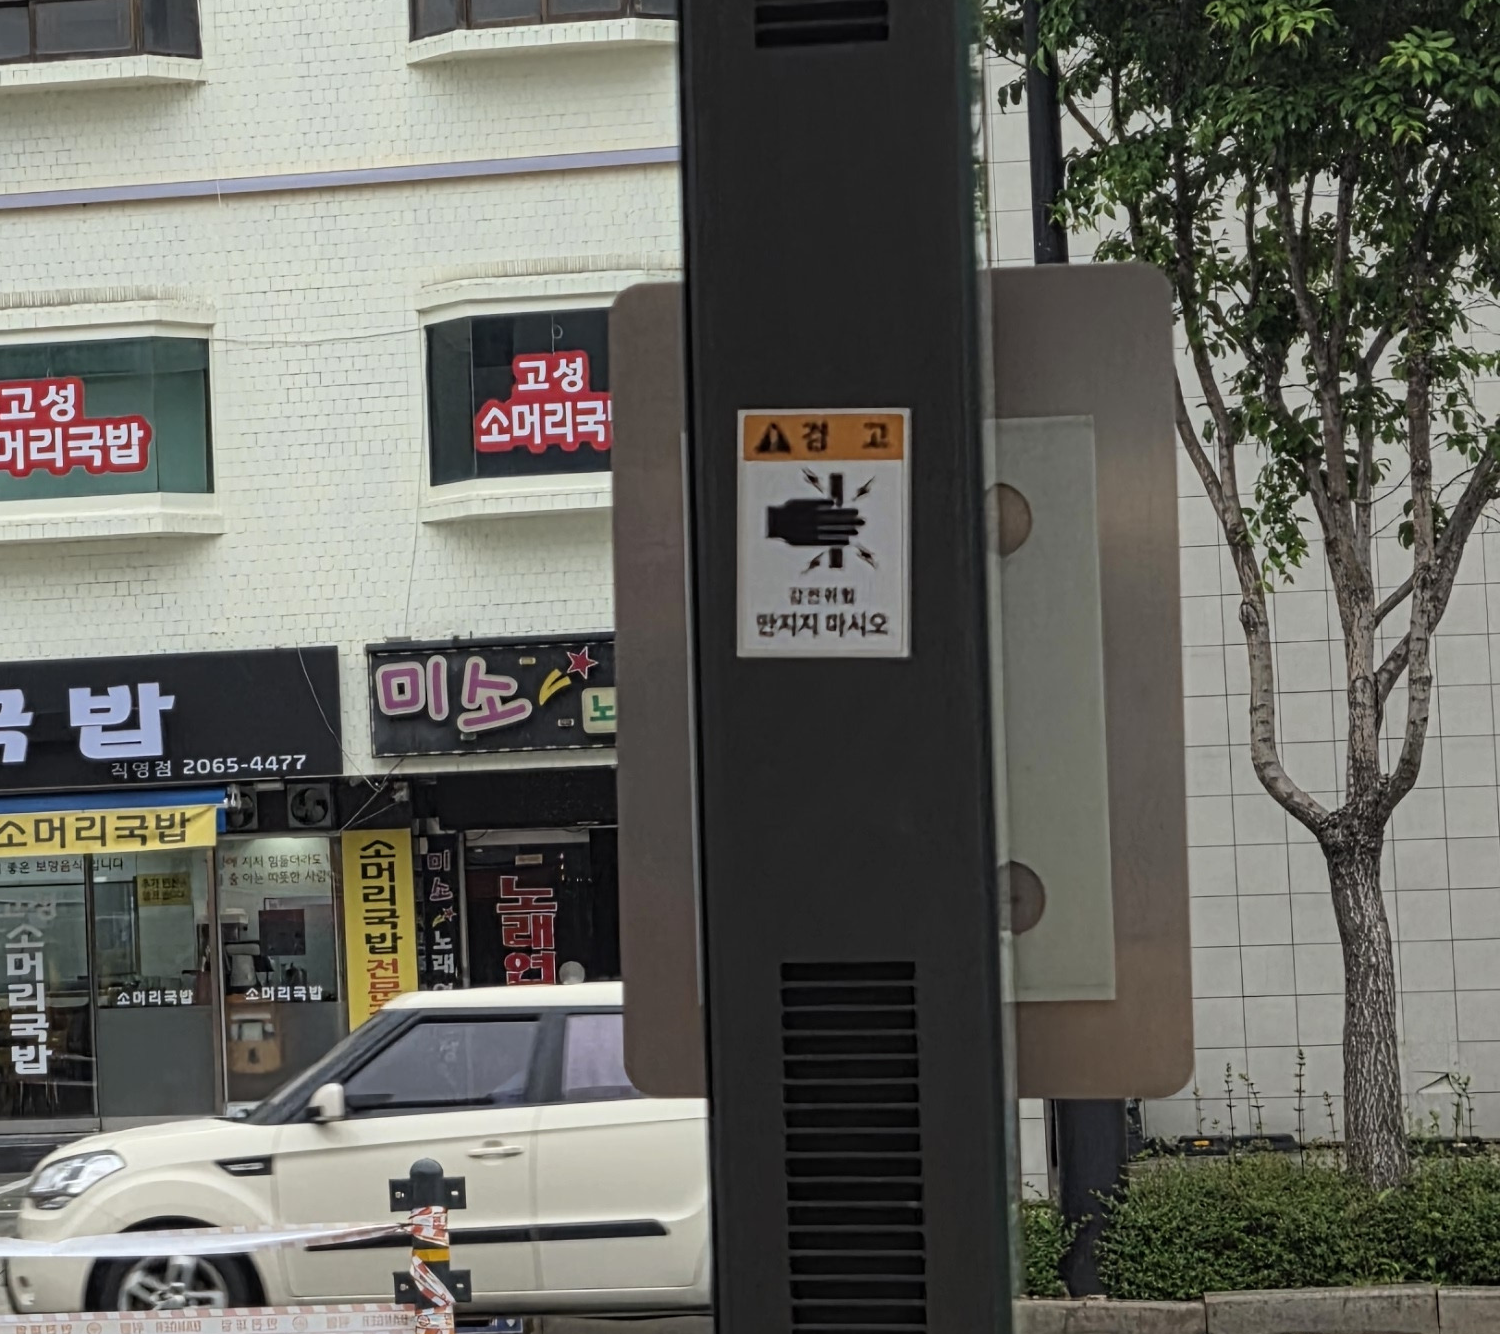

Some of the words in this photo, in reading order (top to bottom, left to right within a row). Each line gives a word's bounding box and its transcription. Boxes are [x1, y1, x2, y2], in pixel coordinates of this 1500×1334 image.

[516, 356, 585, 393] 고성
[479, 399, 612, 445] 소머리국
[374, 653, 534, 733] 미소
[111, 759, 172, 780] 직영점
[182, 753, 307, 775] 2065-4477
[4, 923, 53, 1075] 소머리국밥
[116, 988, 194, 1007] 소머리국밥
[244, 984, 324, 1002] 소머리국밥
